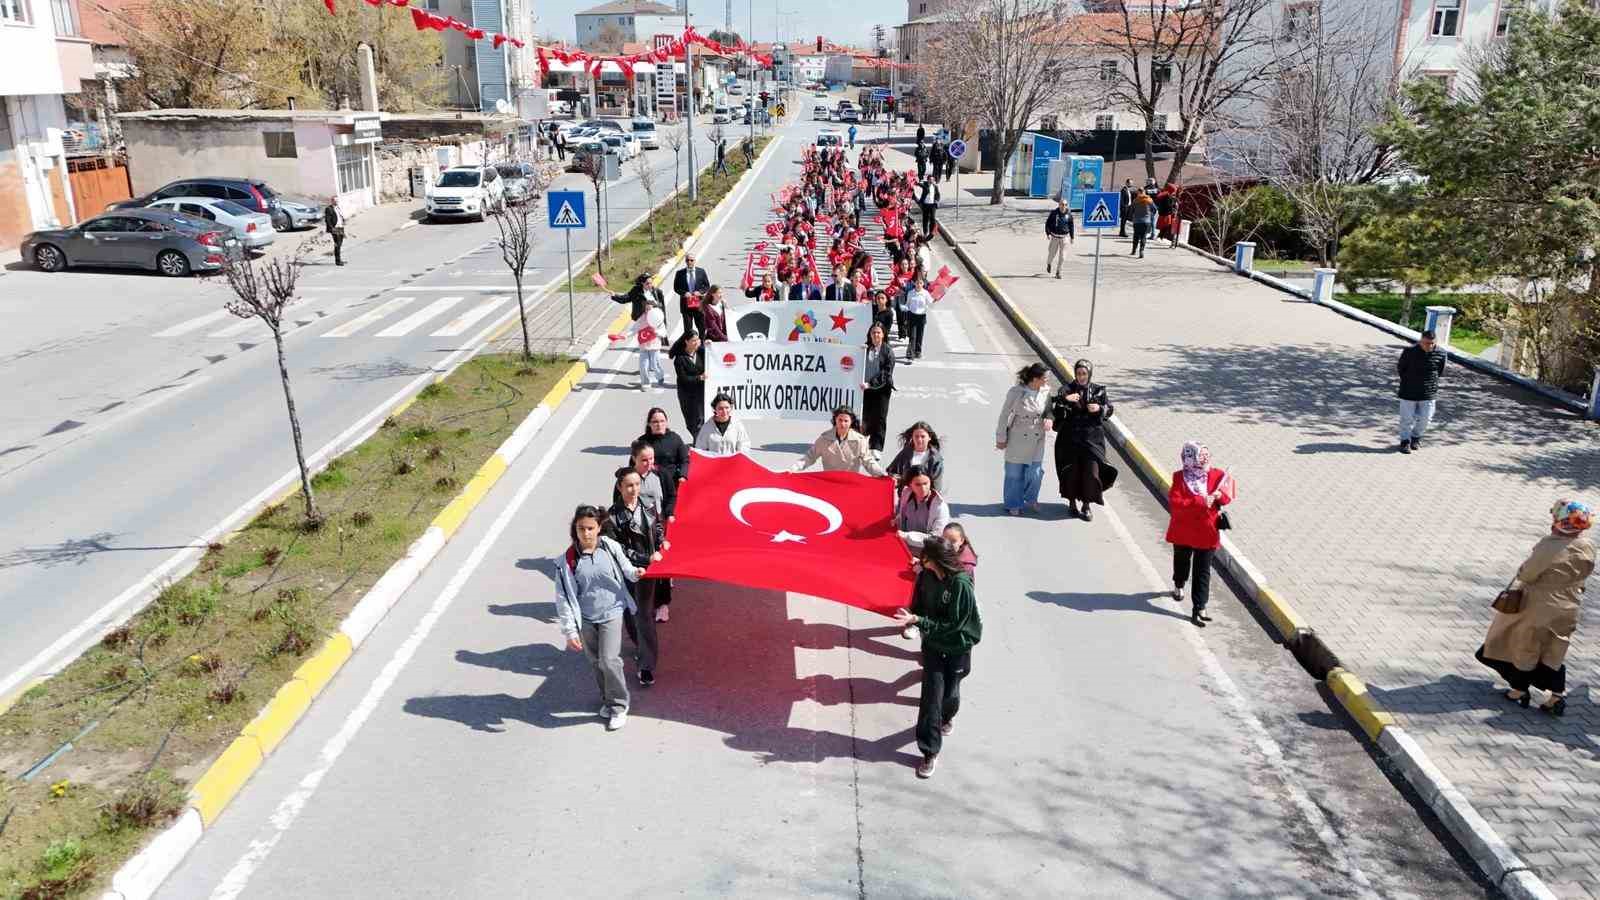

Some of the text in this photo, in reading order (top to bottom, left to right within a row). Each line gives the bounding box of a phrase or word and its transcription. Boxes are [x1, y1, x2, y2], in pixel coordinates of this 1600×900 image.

[743, 354, 826, 373] TOMARZA
[717, 379, 854, 412] ATÜRK ORTAOKULU
